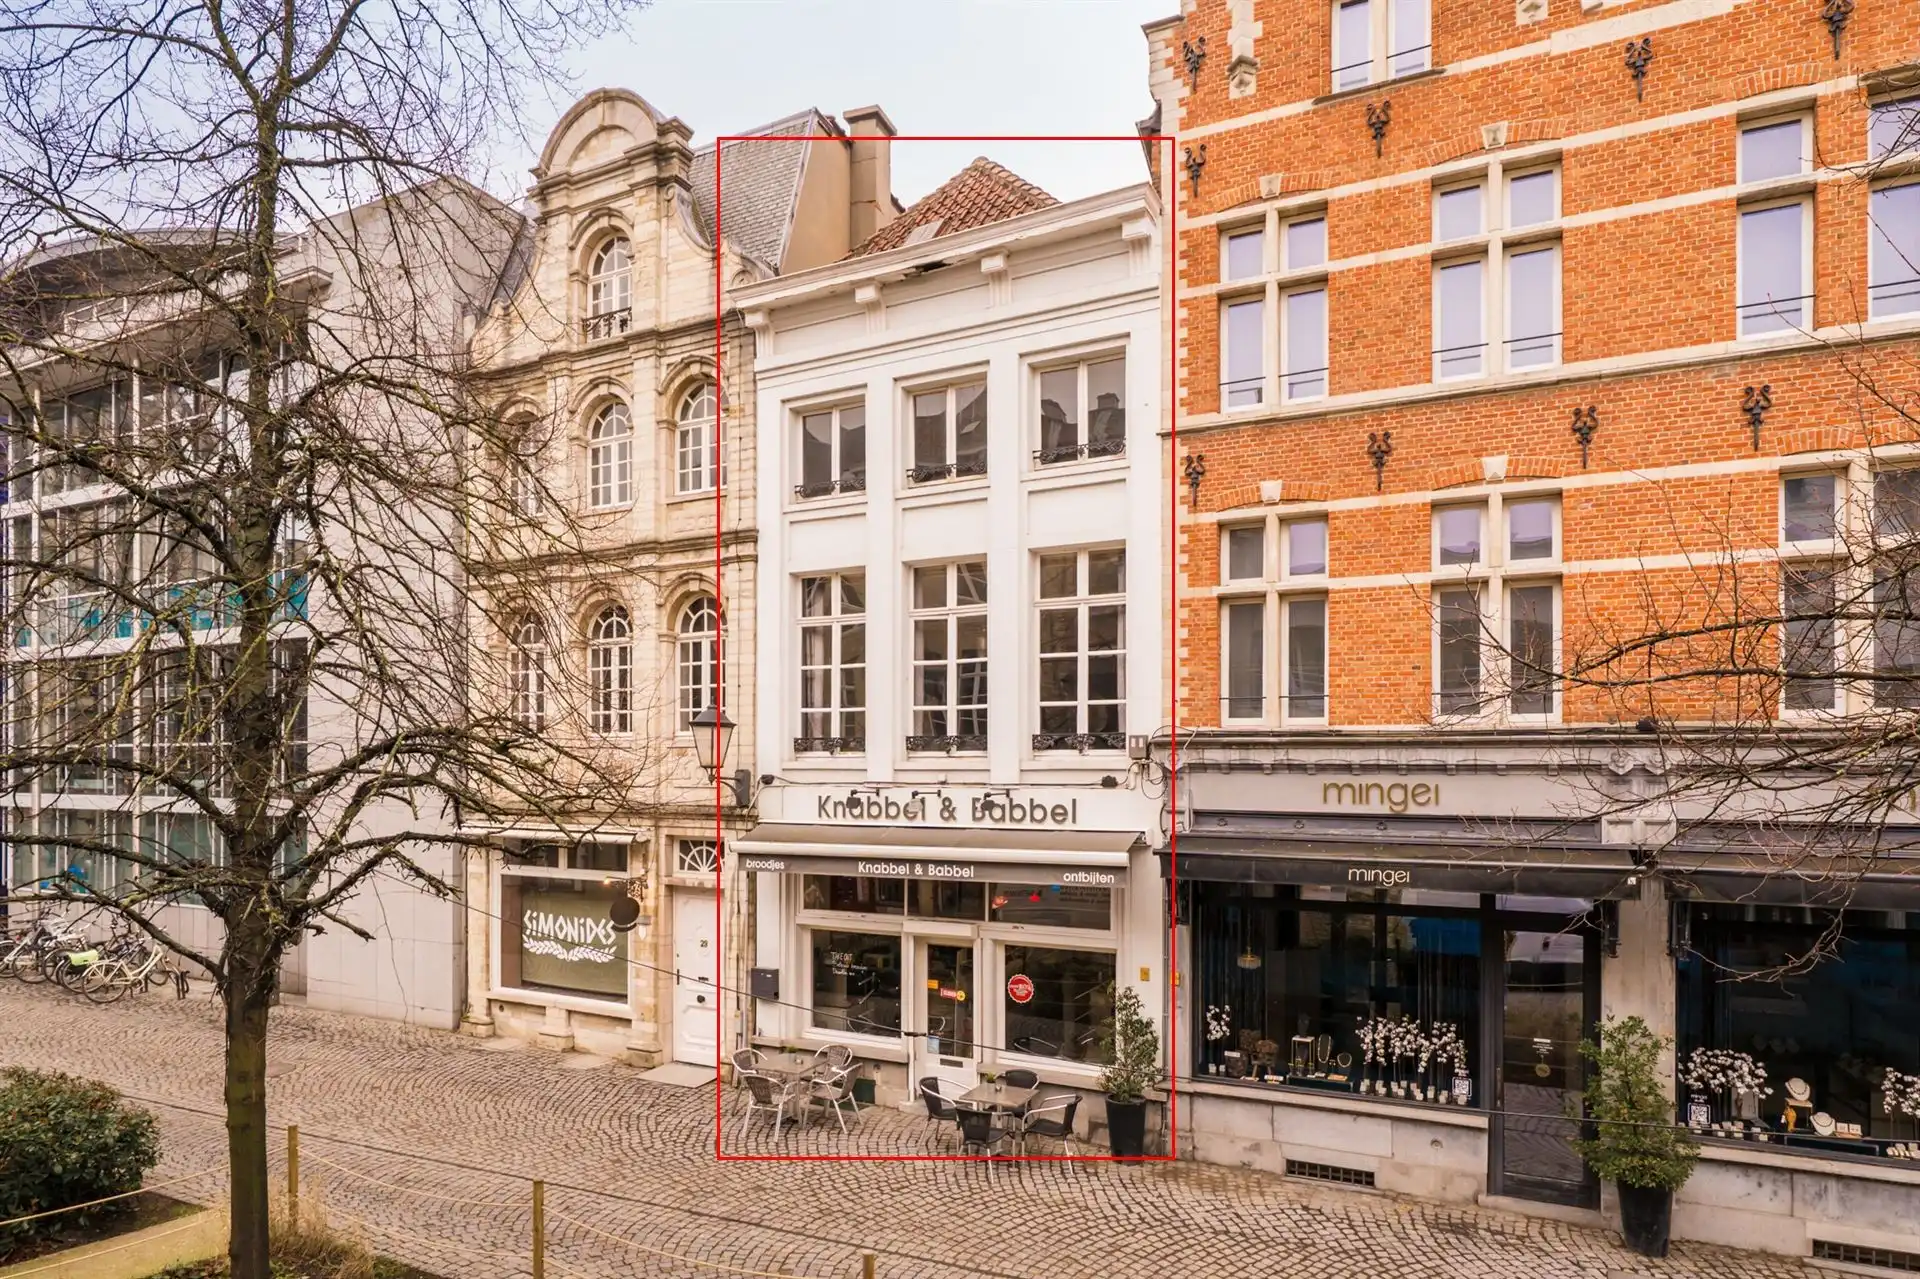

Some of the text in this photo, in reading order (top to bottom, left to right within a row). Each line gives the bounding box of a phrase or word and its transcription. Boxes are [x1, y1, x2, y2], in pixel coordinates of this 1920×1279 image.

[1322, 782, 1440, 813] mingei
[939, 796, 957, 822] &
[971, 797, 1077, 824] Babbel
[745, 858, 785, 871] broodjes
[858, 861, 975, 878] Knabbel & Babbel
[1062, 871, 1115, 885] ontbijten
[1348, 868, 1410, 886] mingei
